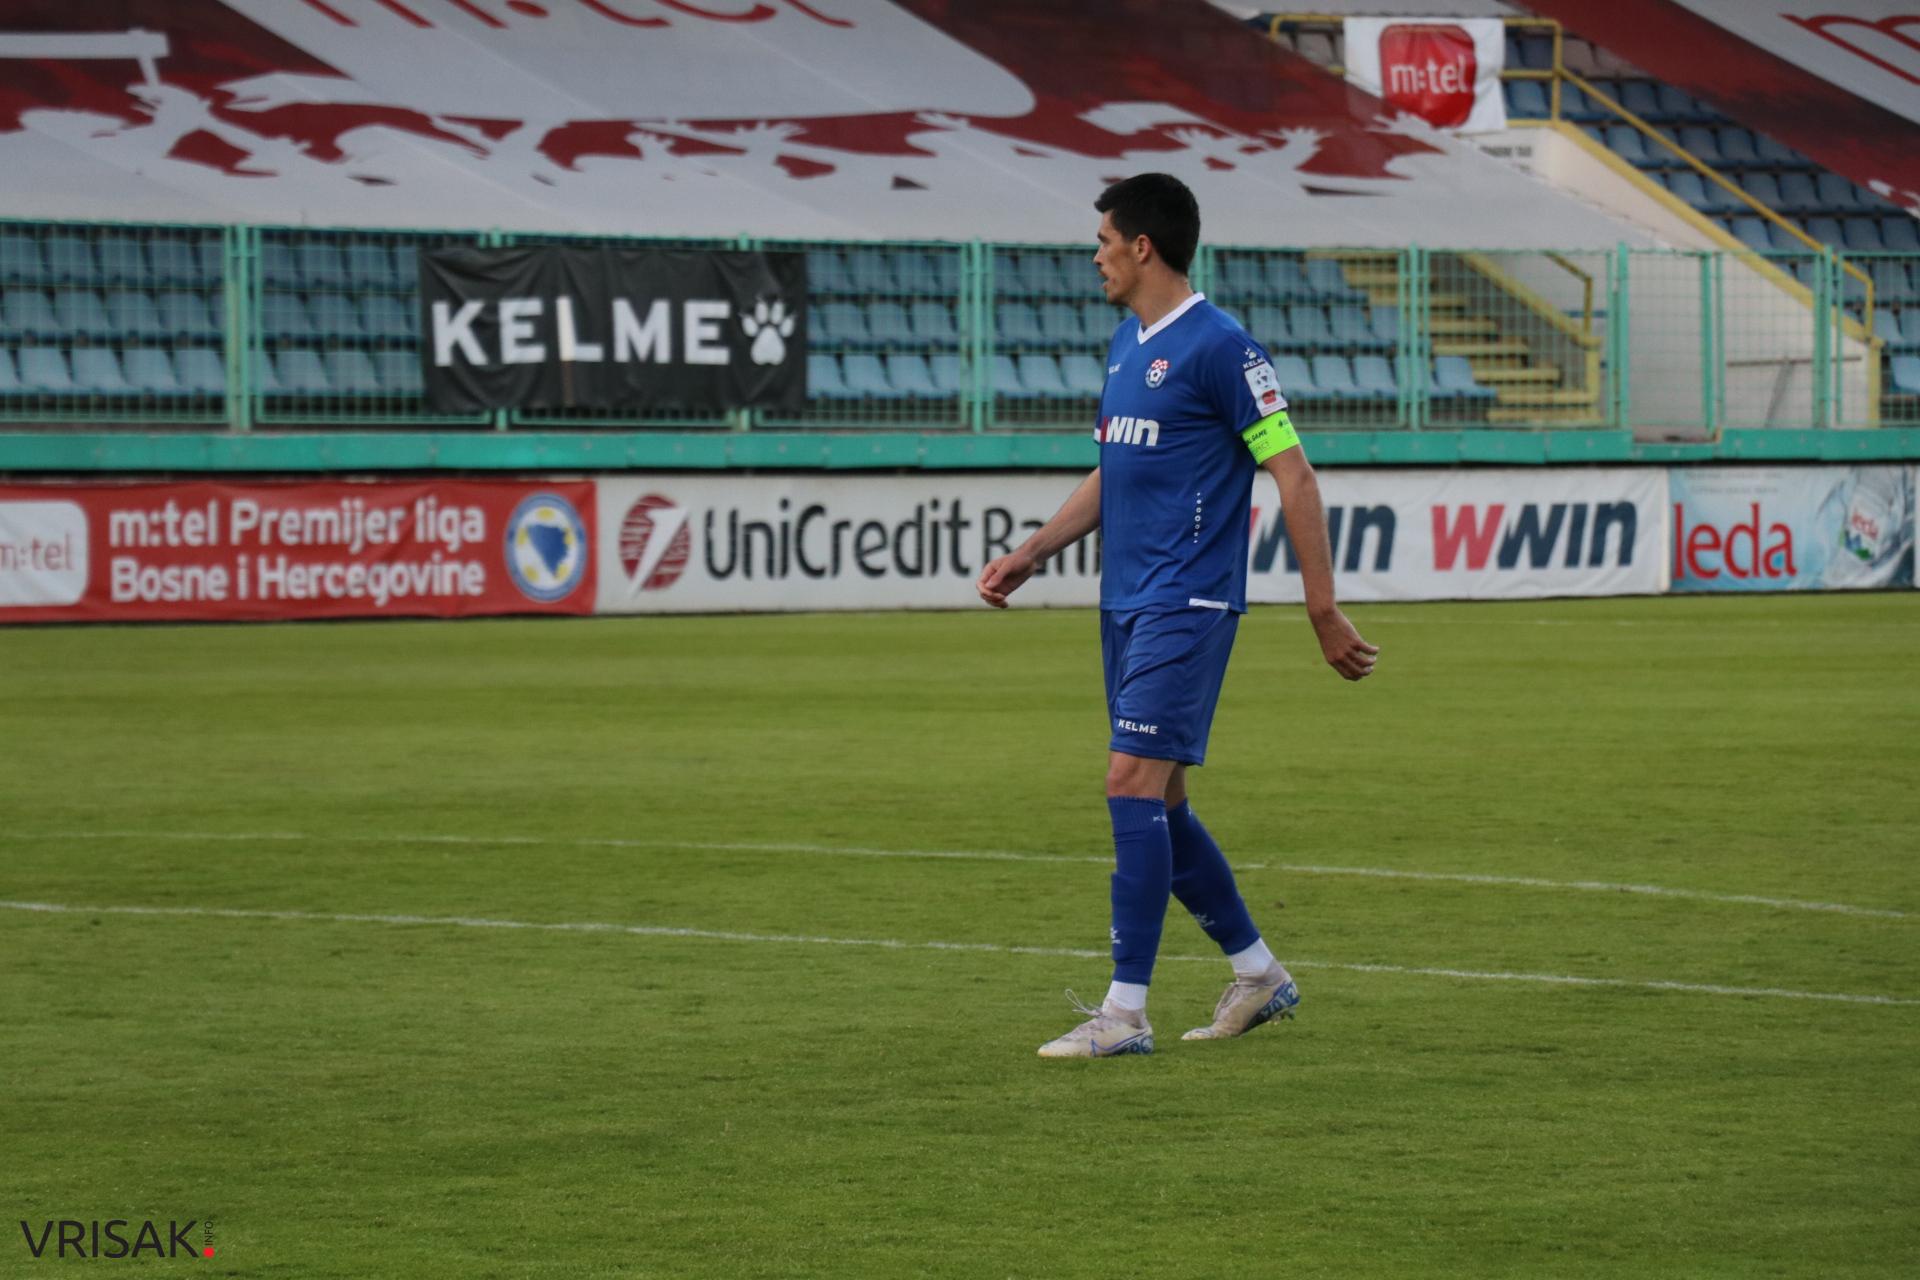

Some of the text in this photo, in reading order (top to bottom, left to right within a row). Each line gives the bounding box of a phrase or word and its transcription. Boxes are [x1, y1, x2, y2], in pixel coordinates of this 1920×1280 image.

[1390, 54, 1470, 95] m:tel
[431, 296, 730, 367] KELME
[109, 497, 485, 553] m:tel Premijer liga
[705, 497, 971, 580] UniCredit
[1673, 502, 1797, 580] leda
[110, 554, 485, 605] Bosne i Hercegovine
[1118, 719, 1158, 735] KELME
